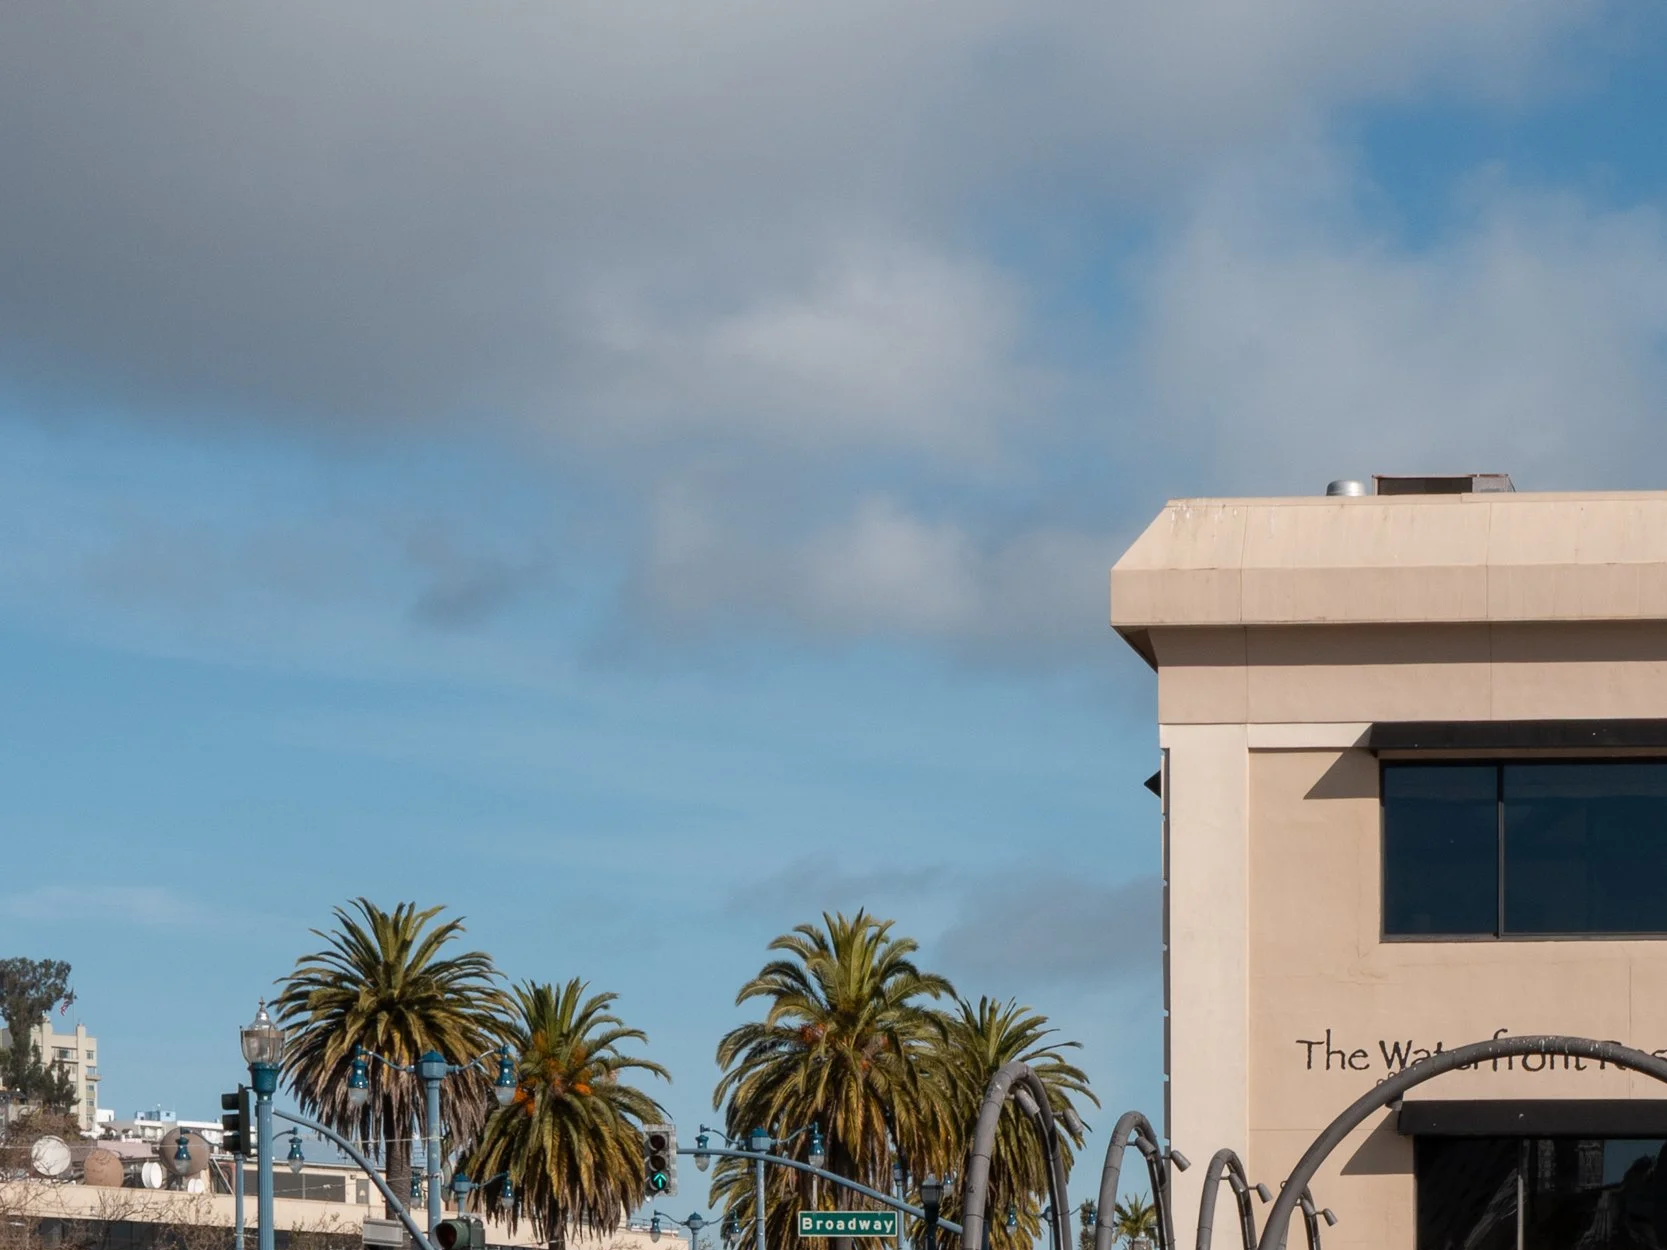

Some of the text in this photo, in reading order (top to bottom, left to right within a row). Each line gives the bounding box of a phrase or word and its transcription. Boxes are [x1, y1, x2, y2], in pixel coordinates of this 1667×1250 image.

[1296, 1029, 1370, 1070] The
[1379, 1028, 1587, 1073] Watfront
[802, 1217, 894, 1233] Broadway
